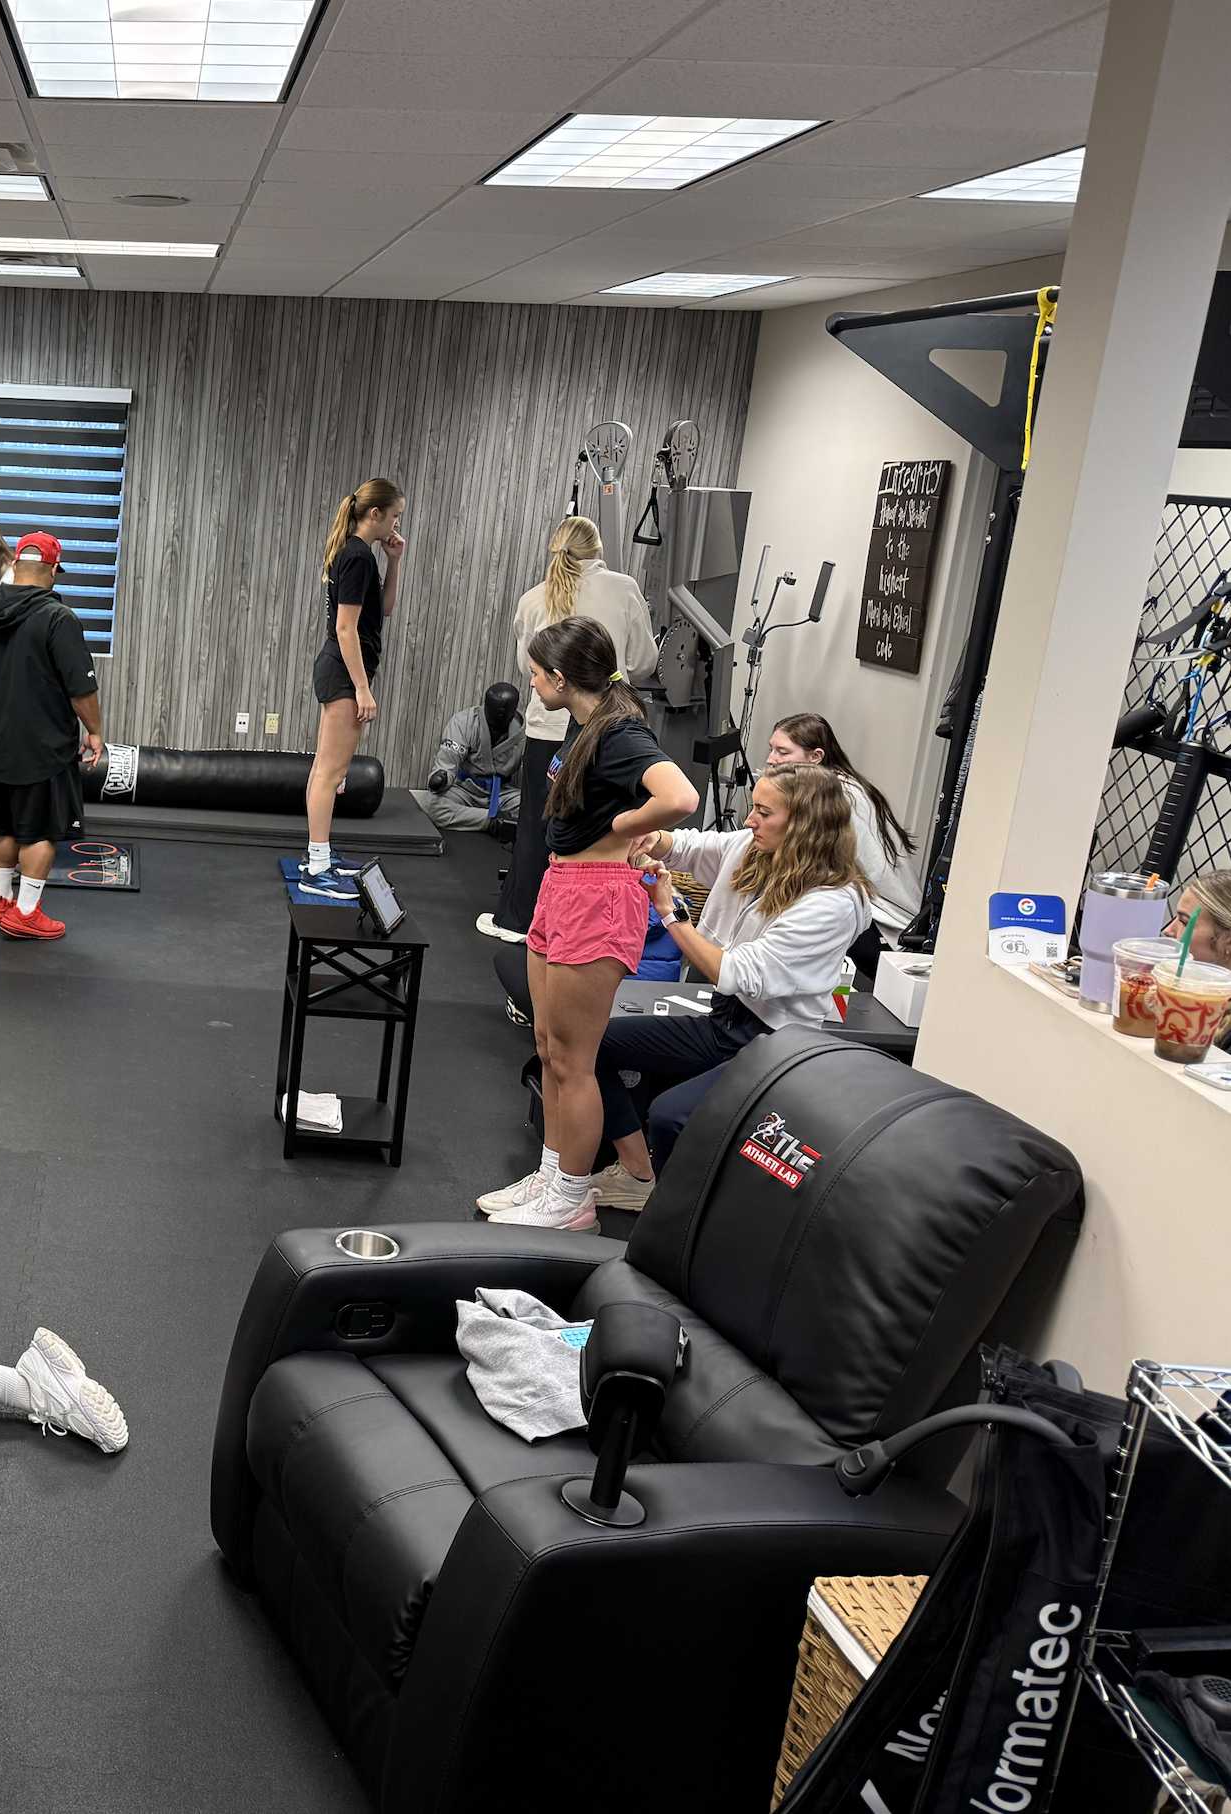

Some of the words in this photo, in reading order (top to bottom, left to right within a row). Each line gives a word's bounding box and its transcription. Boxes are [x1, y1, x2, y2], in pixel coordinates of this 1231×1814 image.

[879, 461, 943, 496] Integrity
[885, 531, 893, 560] to
[897, 533, 909, 560] the
[879, 564, 909, 598] highest
[875, 633, 893, 662] code
[777, 1166, 798, 1184] LAB
[970, 1602, 1082, 1814] ormatec
